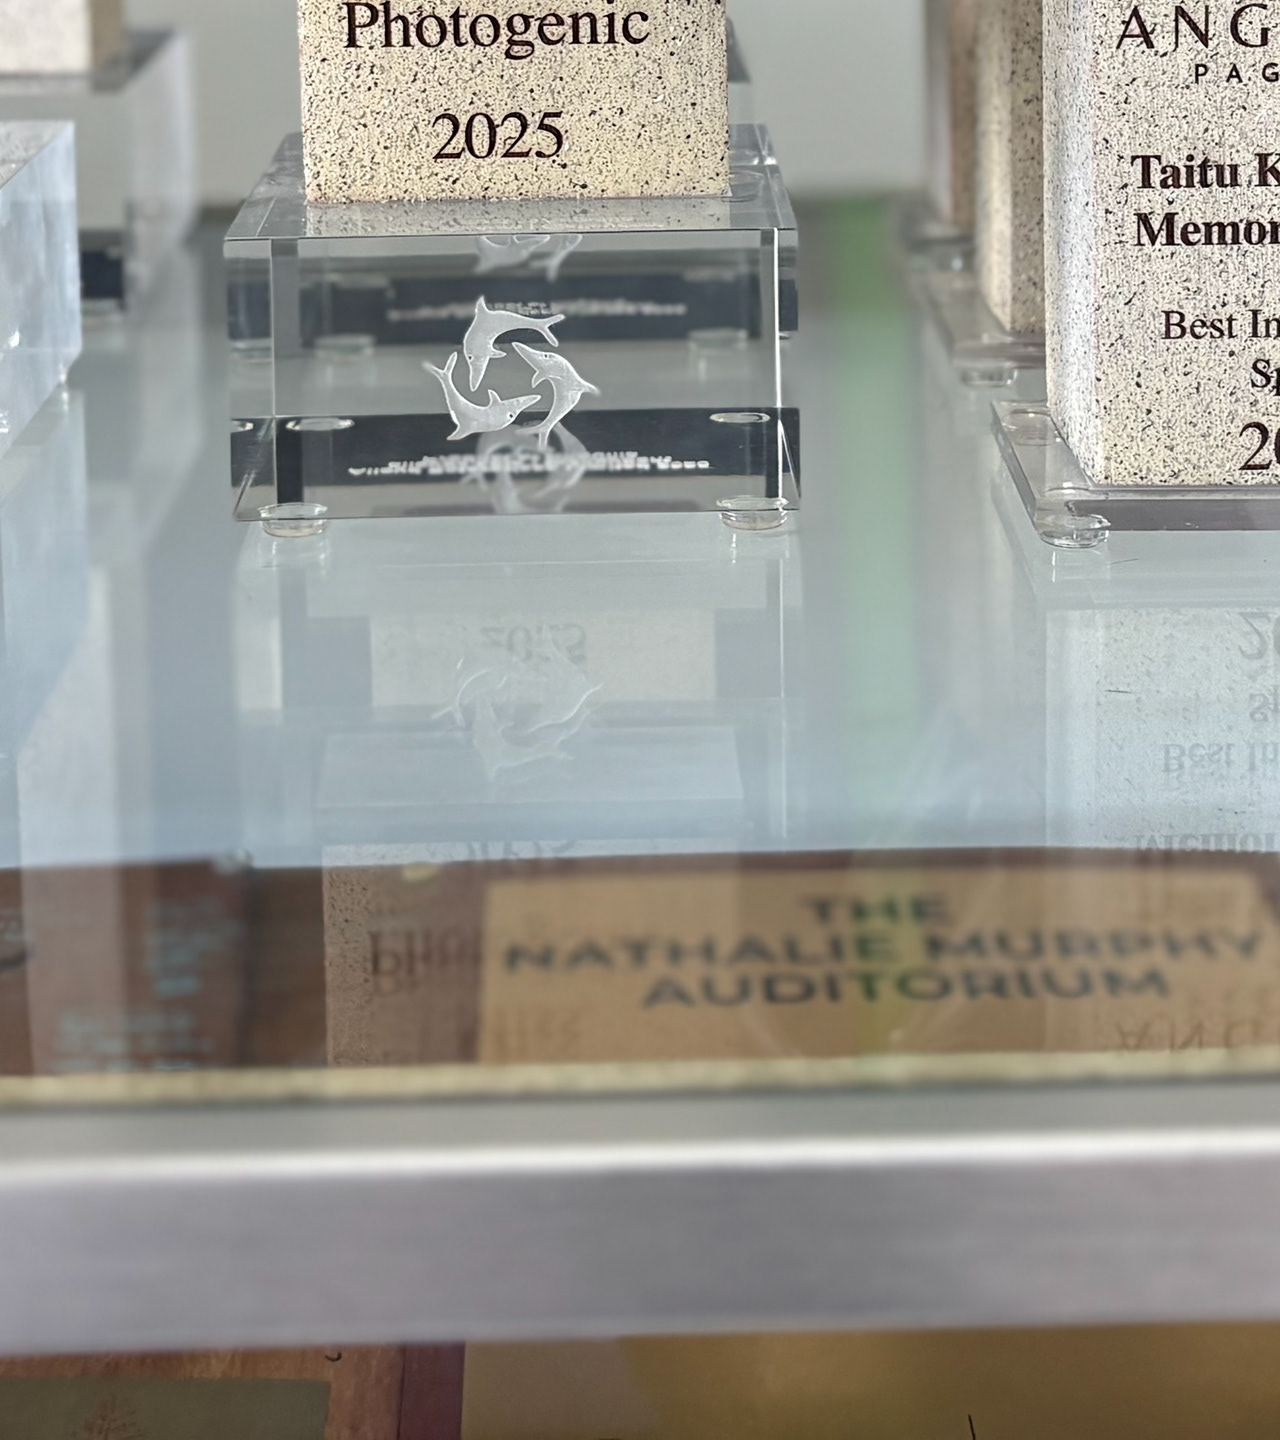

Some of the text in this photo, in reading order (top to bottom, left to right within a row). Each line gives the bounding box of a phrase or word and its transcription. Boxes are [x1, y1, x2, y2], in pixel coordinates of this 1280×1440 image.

[431, 111, 566, 160] 2025
[1130, 154, 1239, 191] Taitu
[1161, 310, 1236, 341] Best
[800, 894, 950, 929] THE
[502, 927, 890, 976] NATHALIE
[922, 920, 1269, 966] MURPHY
[641, 962, 1172, 1010] AUDITORIUM
